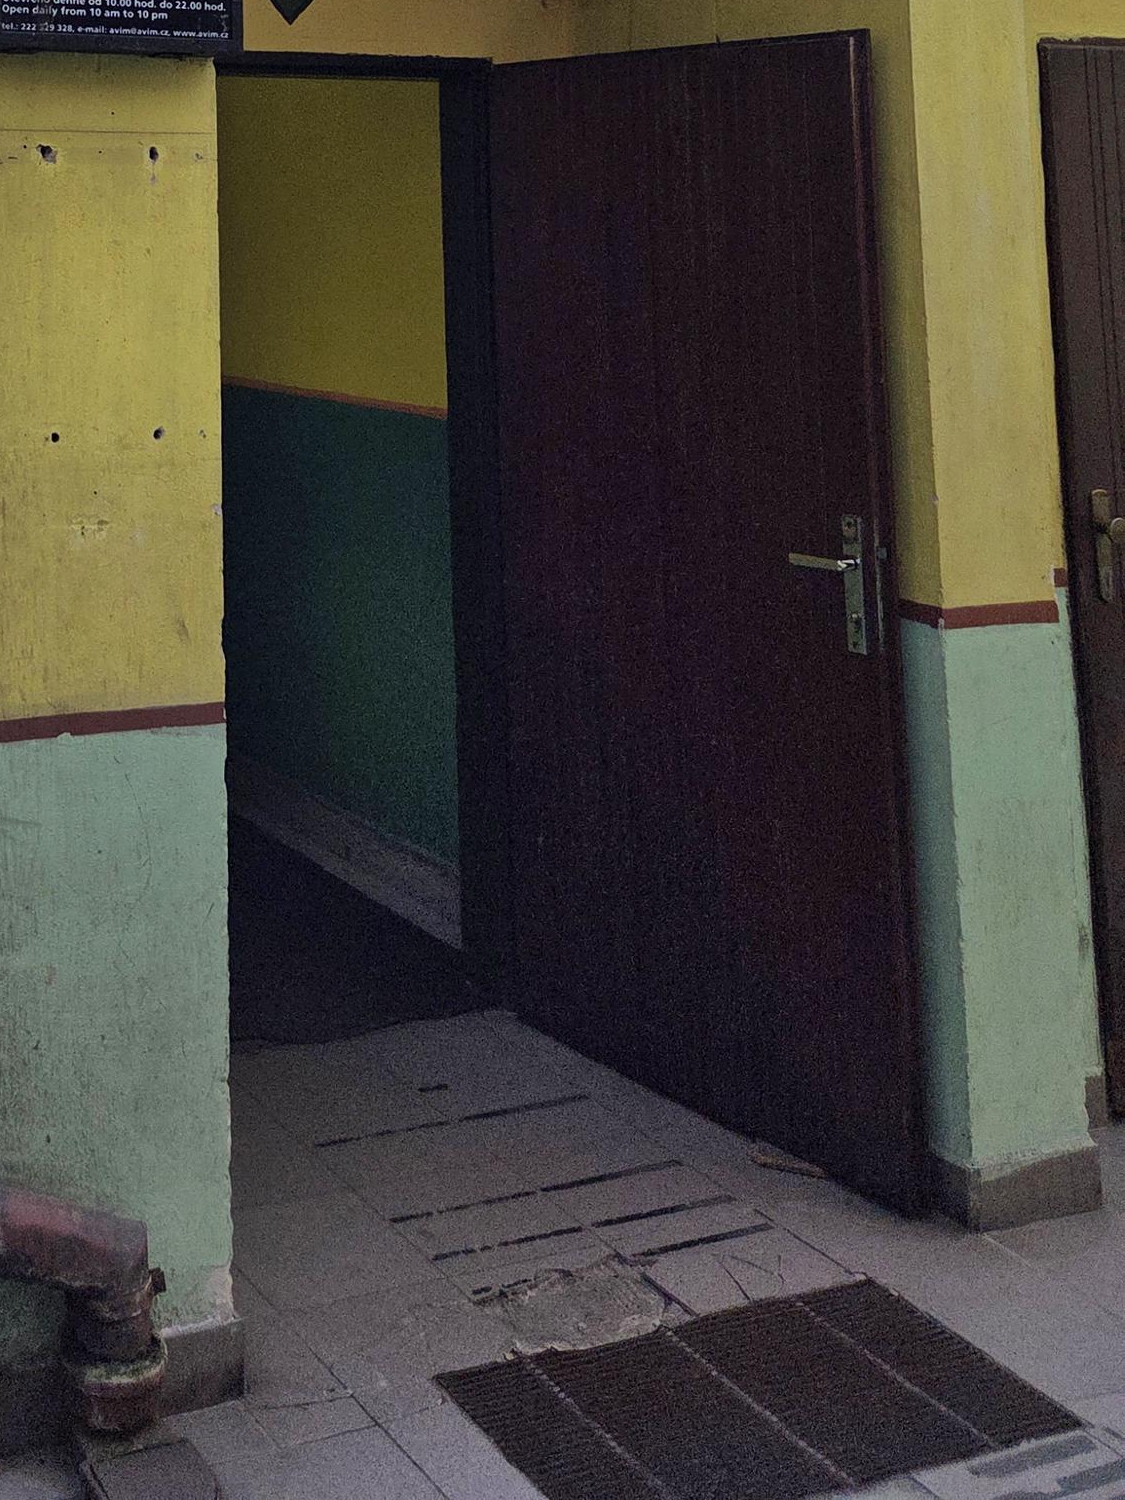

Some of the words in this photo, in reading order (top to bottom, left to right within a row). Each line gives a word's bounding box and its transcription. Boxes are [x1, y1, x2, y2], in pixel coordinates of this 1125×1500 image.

[134, 0, 157, 8] hod.
[159, 0, 173, 9] do
[175, 1, 202, 10] 22.00
[204, 2, 227, 11] hod.
[2, 4, 30, 15] Open
[32, 5, 58, 17] daily
[61, 6, 86, 16] from
[89, 8, 102, 17] 10
[123, 10, 134, 18] to
[137, 10, 149, 19] 10
[151, 12, 168, 21] pm
[21, 23, 36, 31] 222
